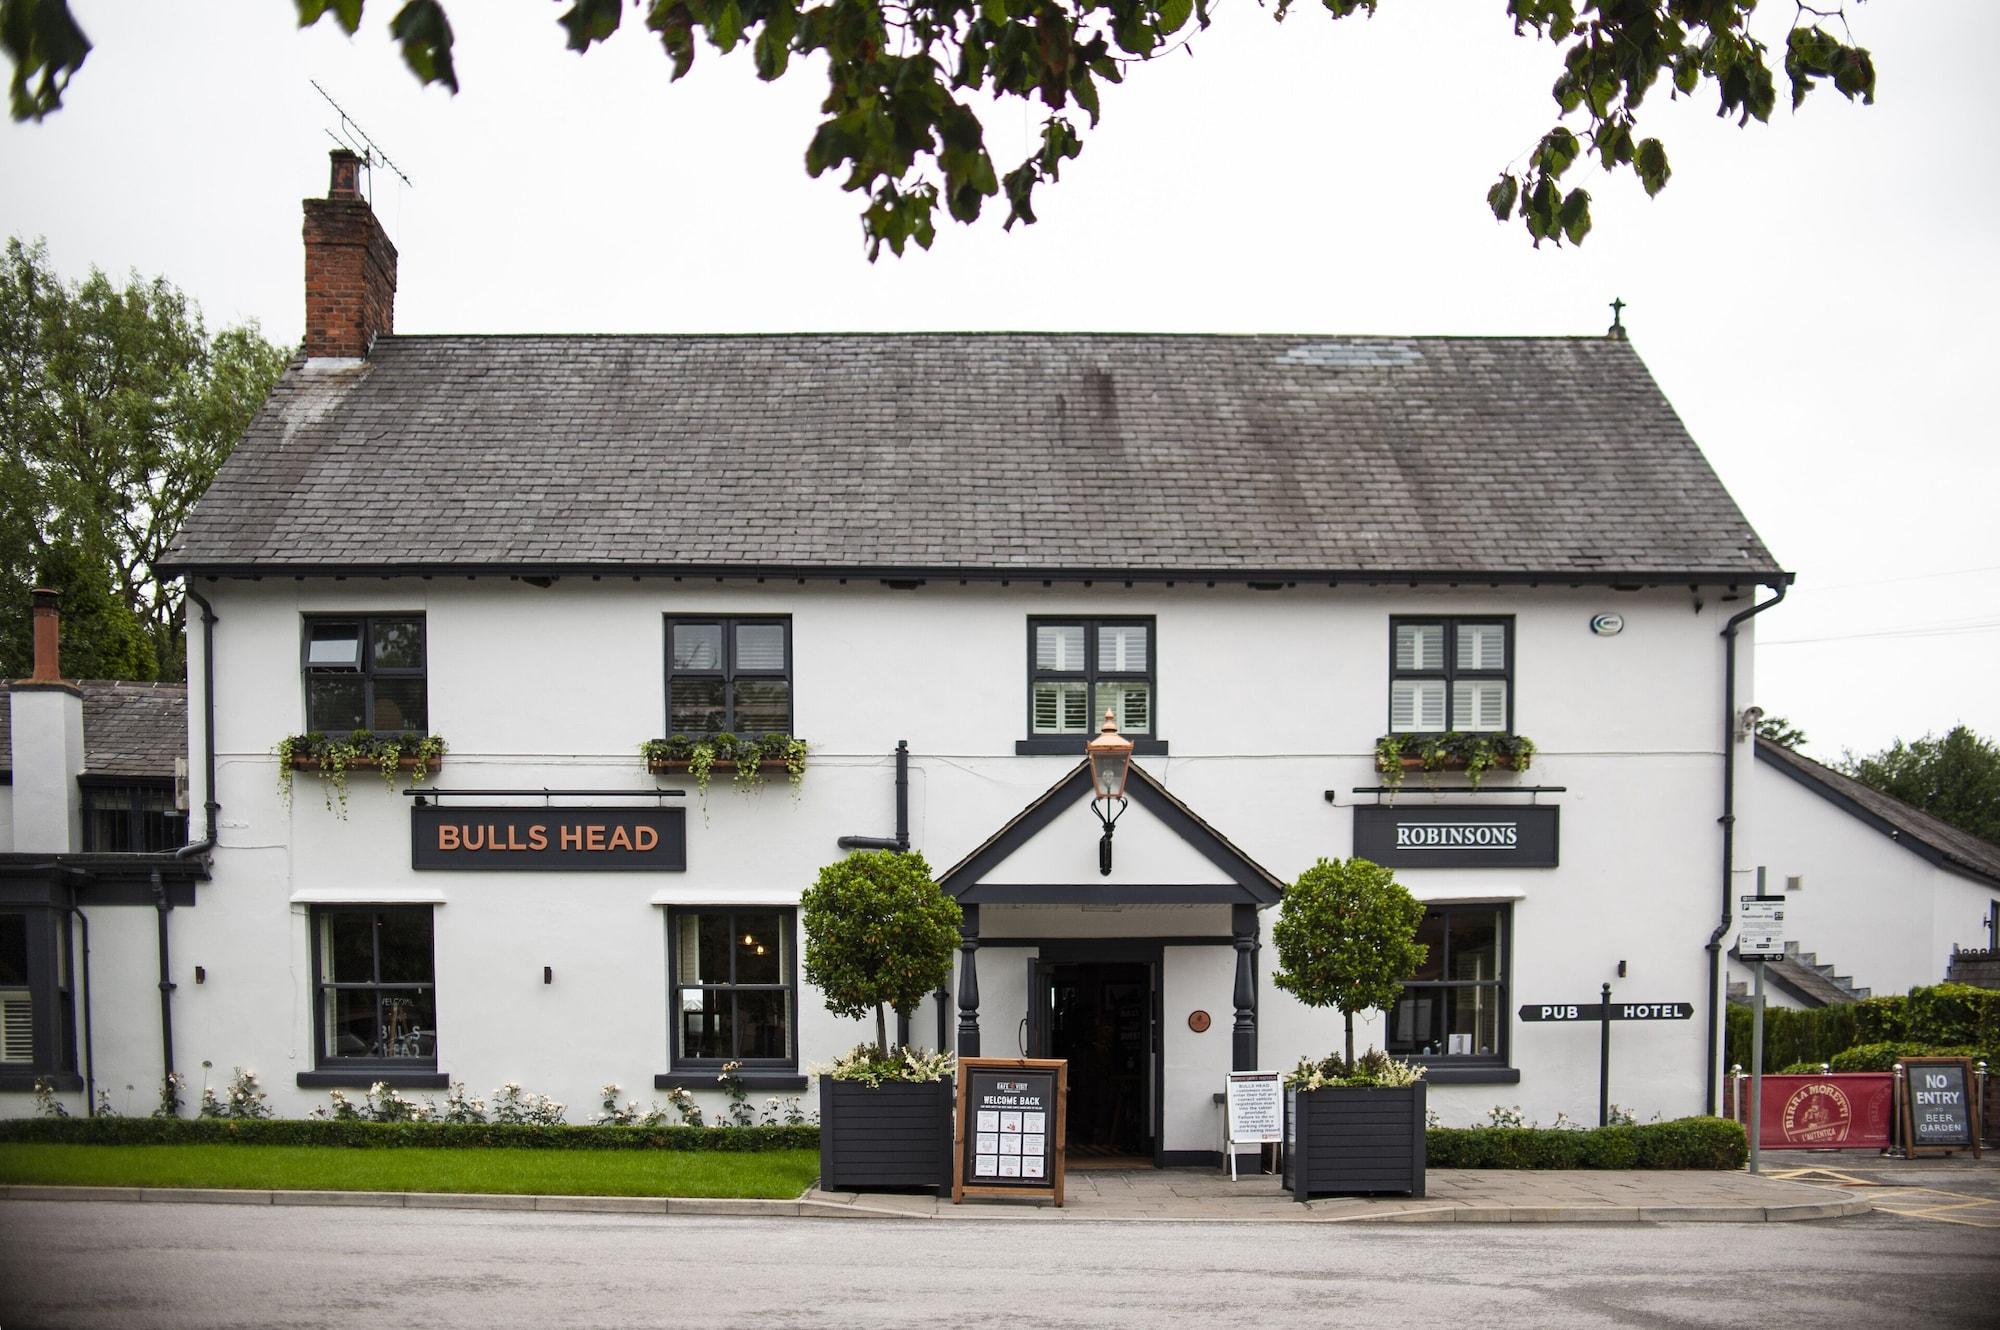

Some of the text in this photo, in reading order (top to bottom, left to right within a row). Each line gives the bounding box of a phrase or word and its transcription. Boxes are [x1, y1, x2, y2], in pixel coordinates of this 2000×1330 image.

[438, 824, 659, 851] BULLS HEAD
[1396, 826, 1518, 845] ROBINSONS
[1541, 1006, 1579, 1020] PUB
[1623, 1005, 1684, 1018] HOTEL
[1925, 1074, 1948, 1089] NO
[983, 1095, 1041, 1106] WELCOME BACK
[1916, 1091, 1960, 1105] ENTRY
[1785, 1084, 1849, 1129] BIRRA MORETTI
[1925, 1113, 1954, 1123] BEER
[1919, 1123, 1962, 1132] GARDEN
